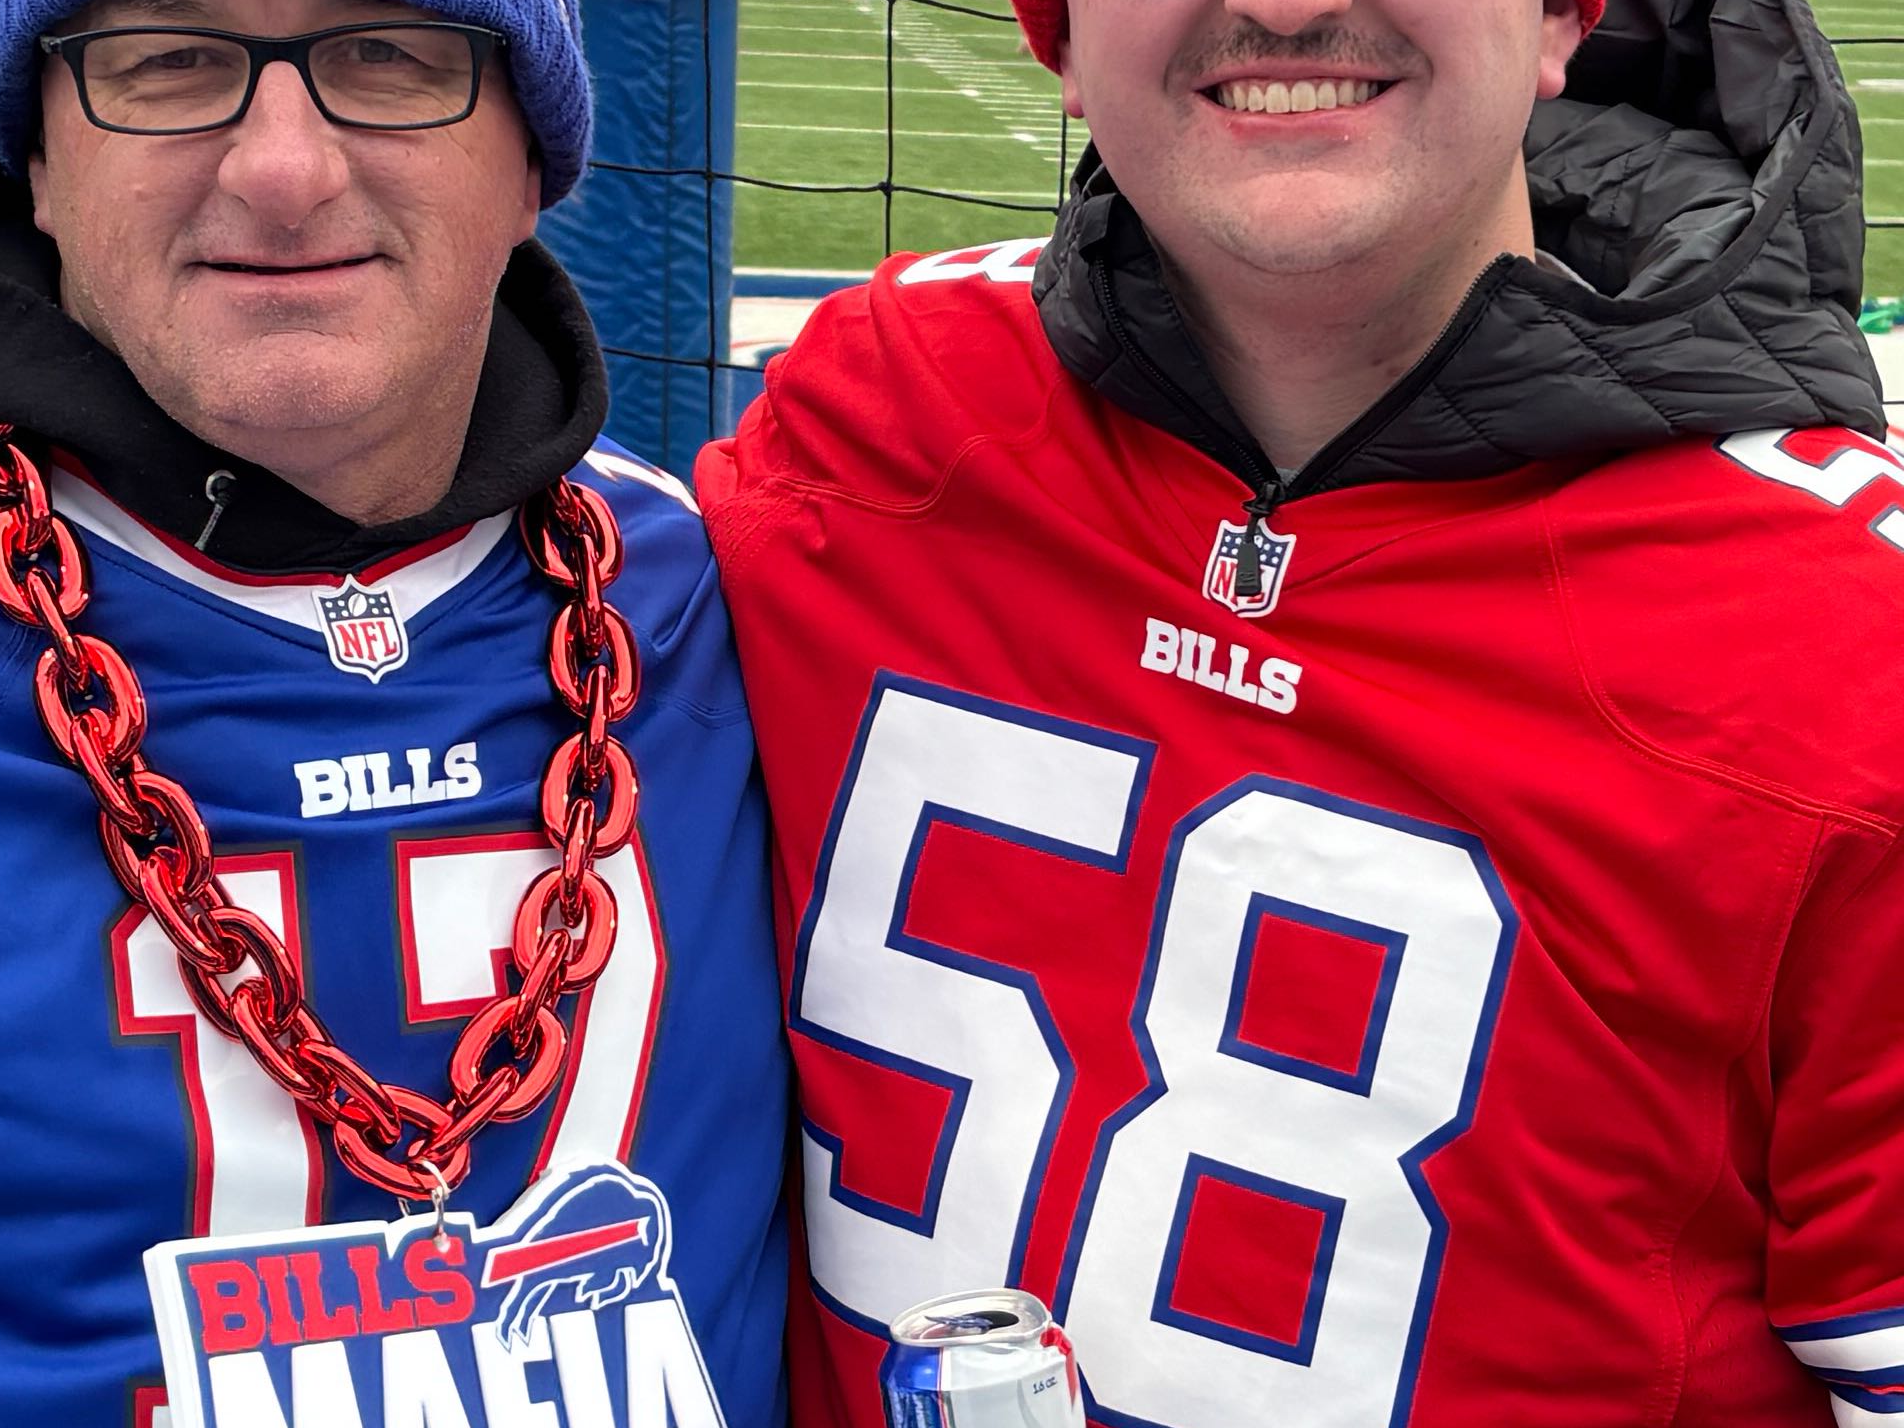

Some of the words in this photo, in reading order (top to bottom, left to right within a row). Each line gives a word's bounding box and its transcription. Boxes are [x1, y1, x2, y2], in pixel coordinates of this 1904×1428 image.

[335, 620, 398, 663] NFL
[1141, 618, 1304, 715] BILLS
[293, 741, 482, 818] BILLS
[189, 1236, 476, 1355] BILLS
